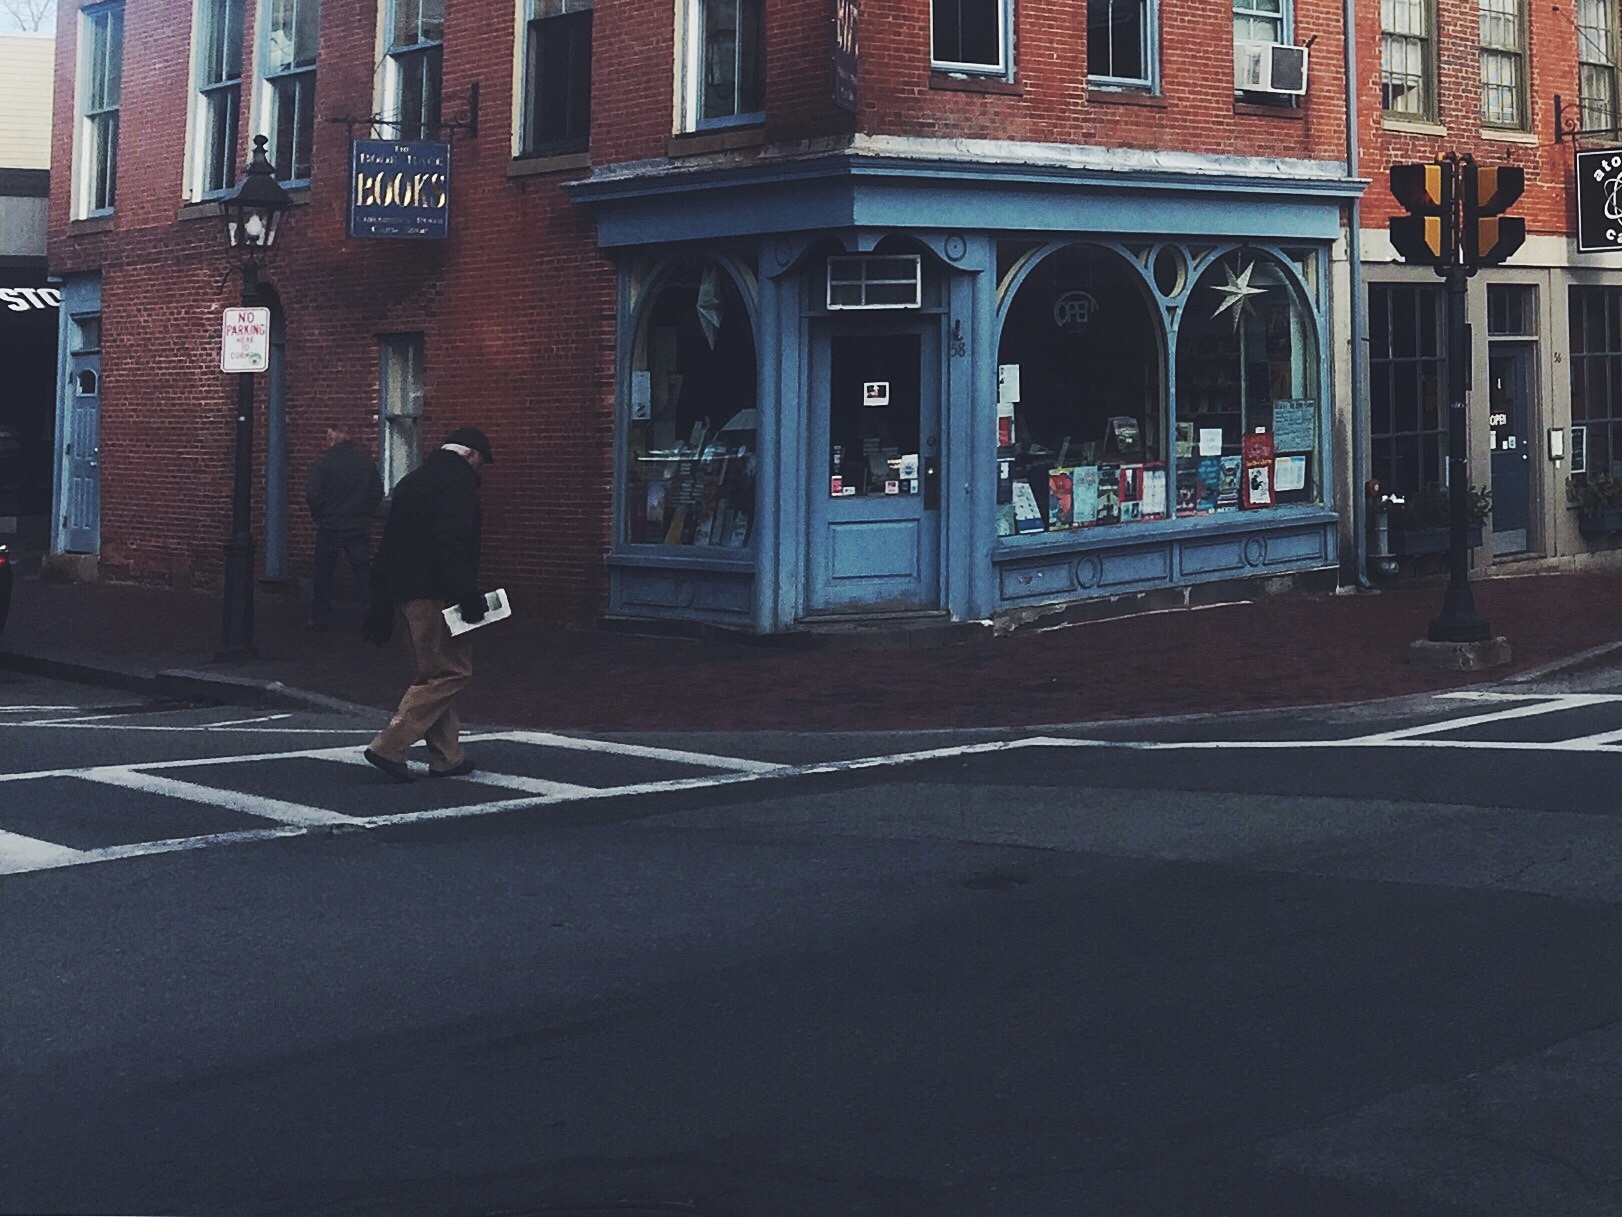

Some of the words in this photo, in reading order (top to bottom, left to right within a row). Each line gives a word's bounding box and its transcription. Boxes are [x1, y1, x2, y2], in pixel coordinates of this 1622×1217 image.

[356, 171, 446, 208] BOOKS
[238, 312, 255, 324] NO
[226, 324, 265, 336] PARKING
